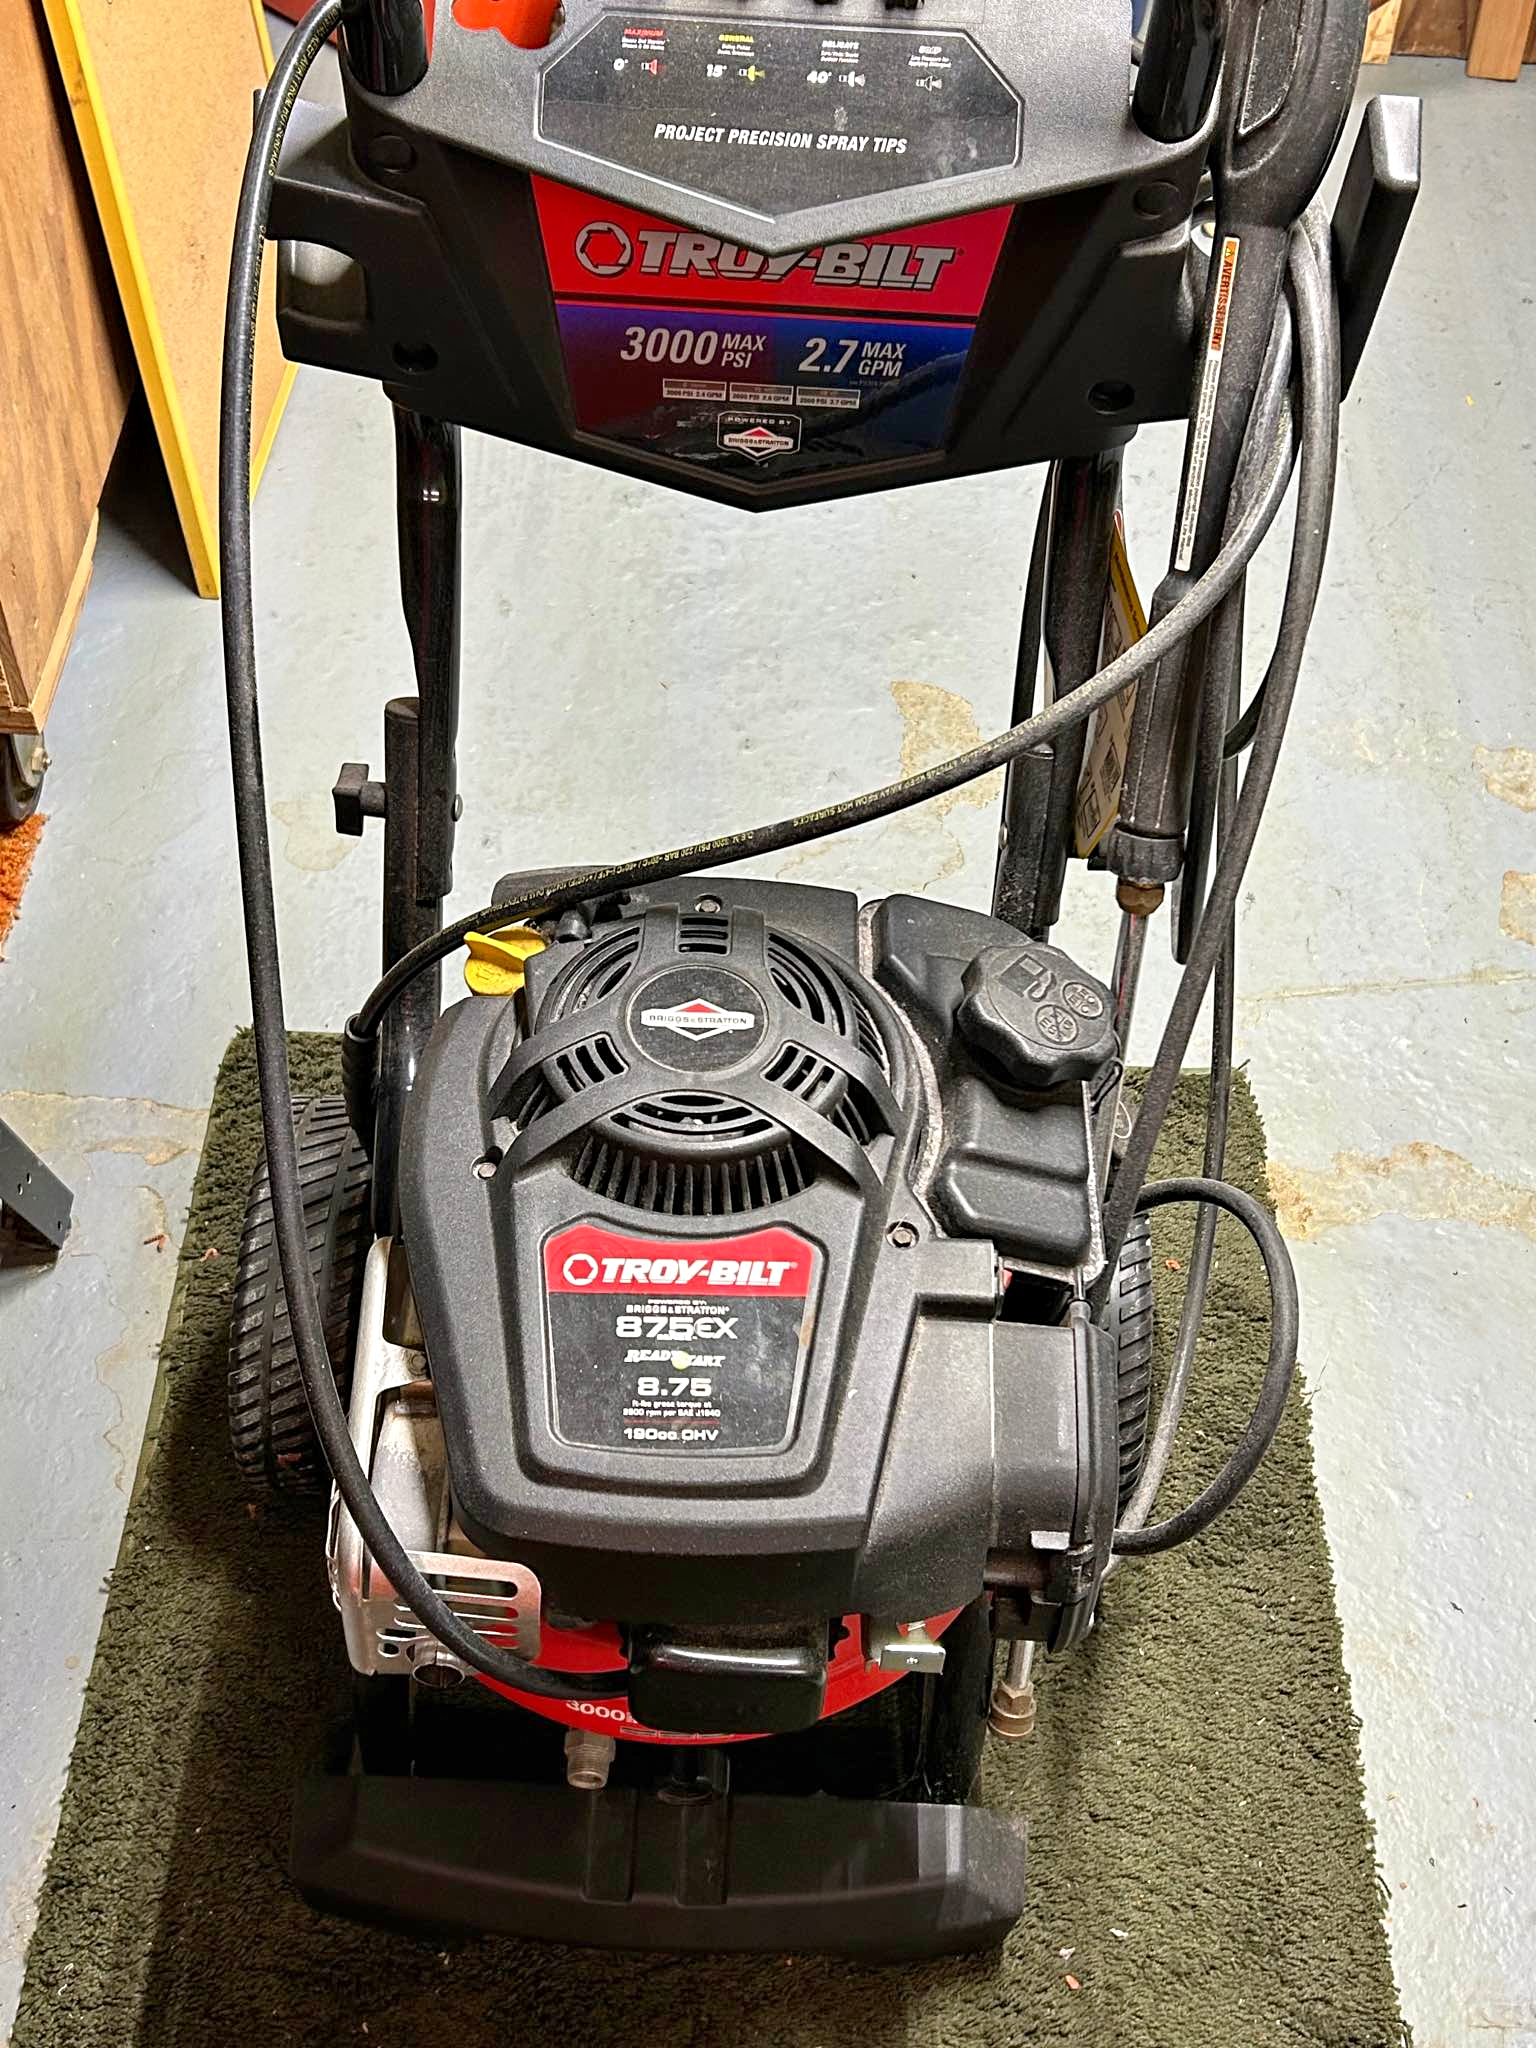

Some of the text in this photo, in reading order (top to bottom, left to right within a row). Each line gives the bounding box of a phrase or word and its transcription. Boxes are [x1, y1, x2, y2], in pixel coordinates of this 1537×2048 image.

[653, 123, 908, 154] PROJECT PRECISION SPRAY TIPS
[1211, 261, 1233, 350] AVERTISSEMENT
[620, 326, 718, 365] 3000
[722, 333, 767, 351] MAX
[862, 342, 907, 359] MAX
[721, 352, 752, 368] PSI
[798, 337, 858, 374] 2.7
[858, 360, 903, 377] GPM
[727, 417, 775, 425] POWERED
[837, 802, 854, 813] HOT
[793, 808, 836, 827] SURFACES
[601, 1257, 790, 1286] TROY-BILT
[616, 1316, 739, 1340] 875EX
[638, 1376, 712, 1397] 8.75
[676, 1400, 702, 1408] torque
[646, 1409, 662, 1418] rpm
[663, 1409, 676, 1418] per
[682, 1429, 719, 1440] OHV
